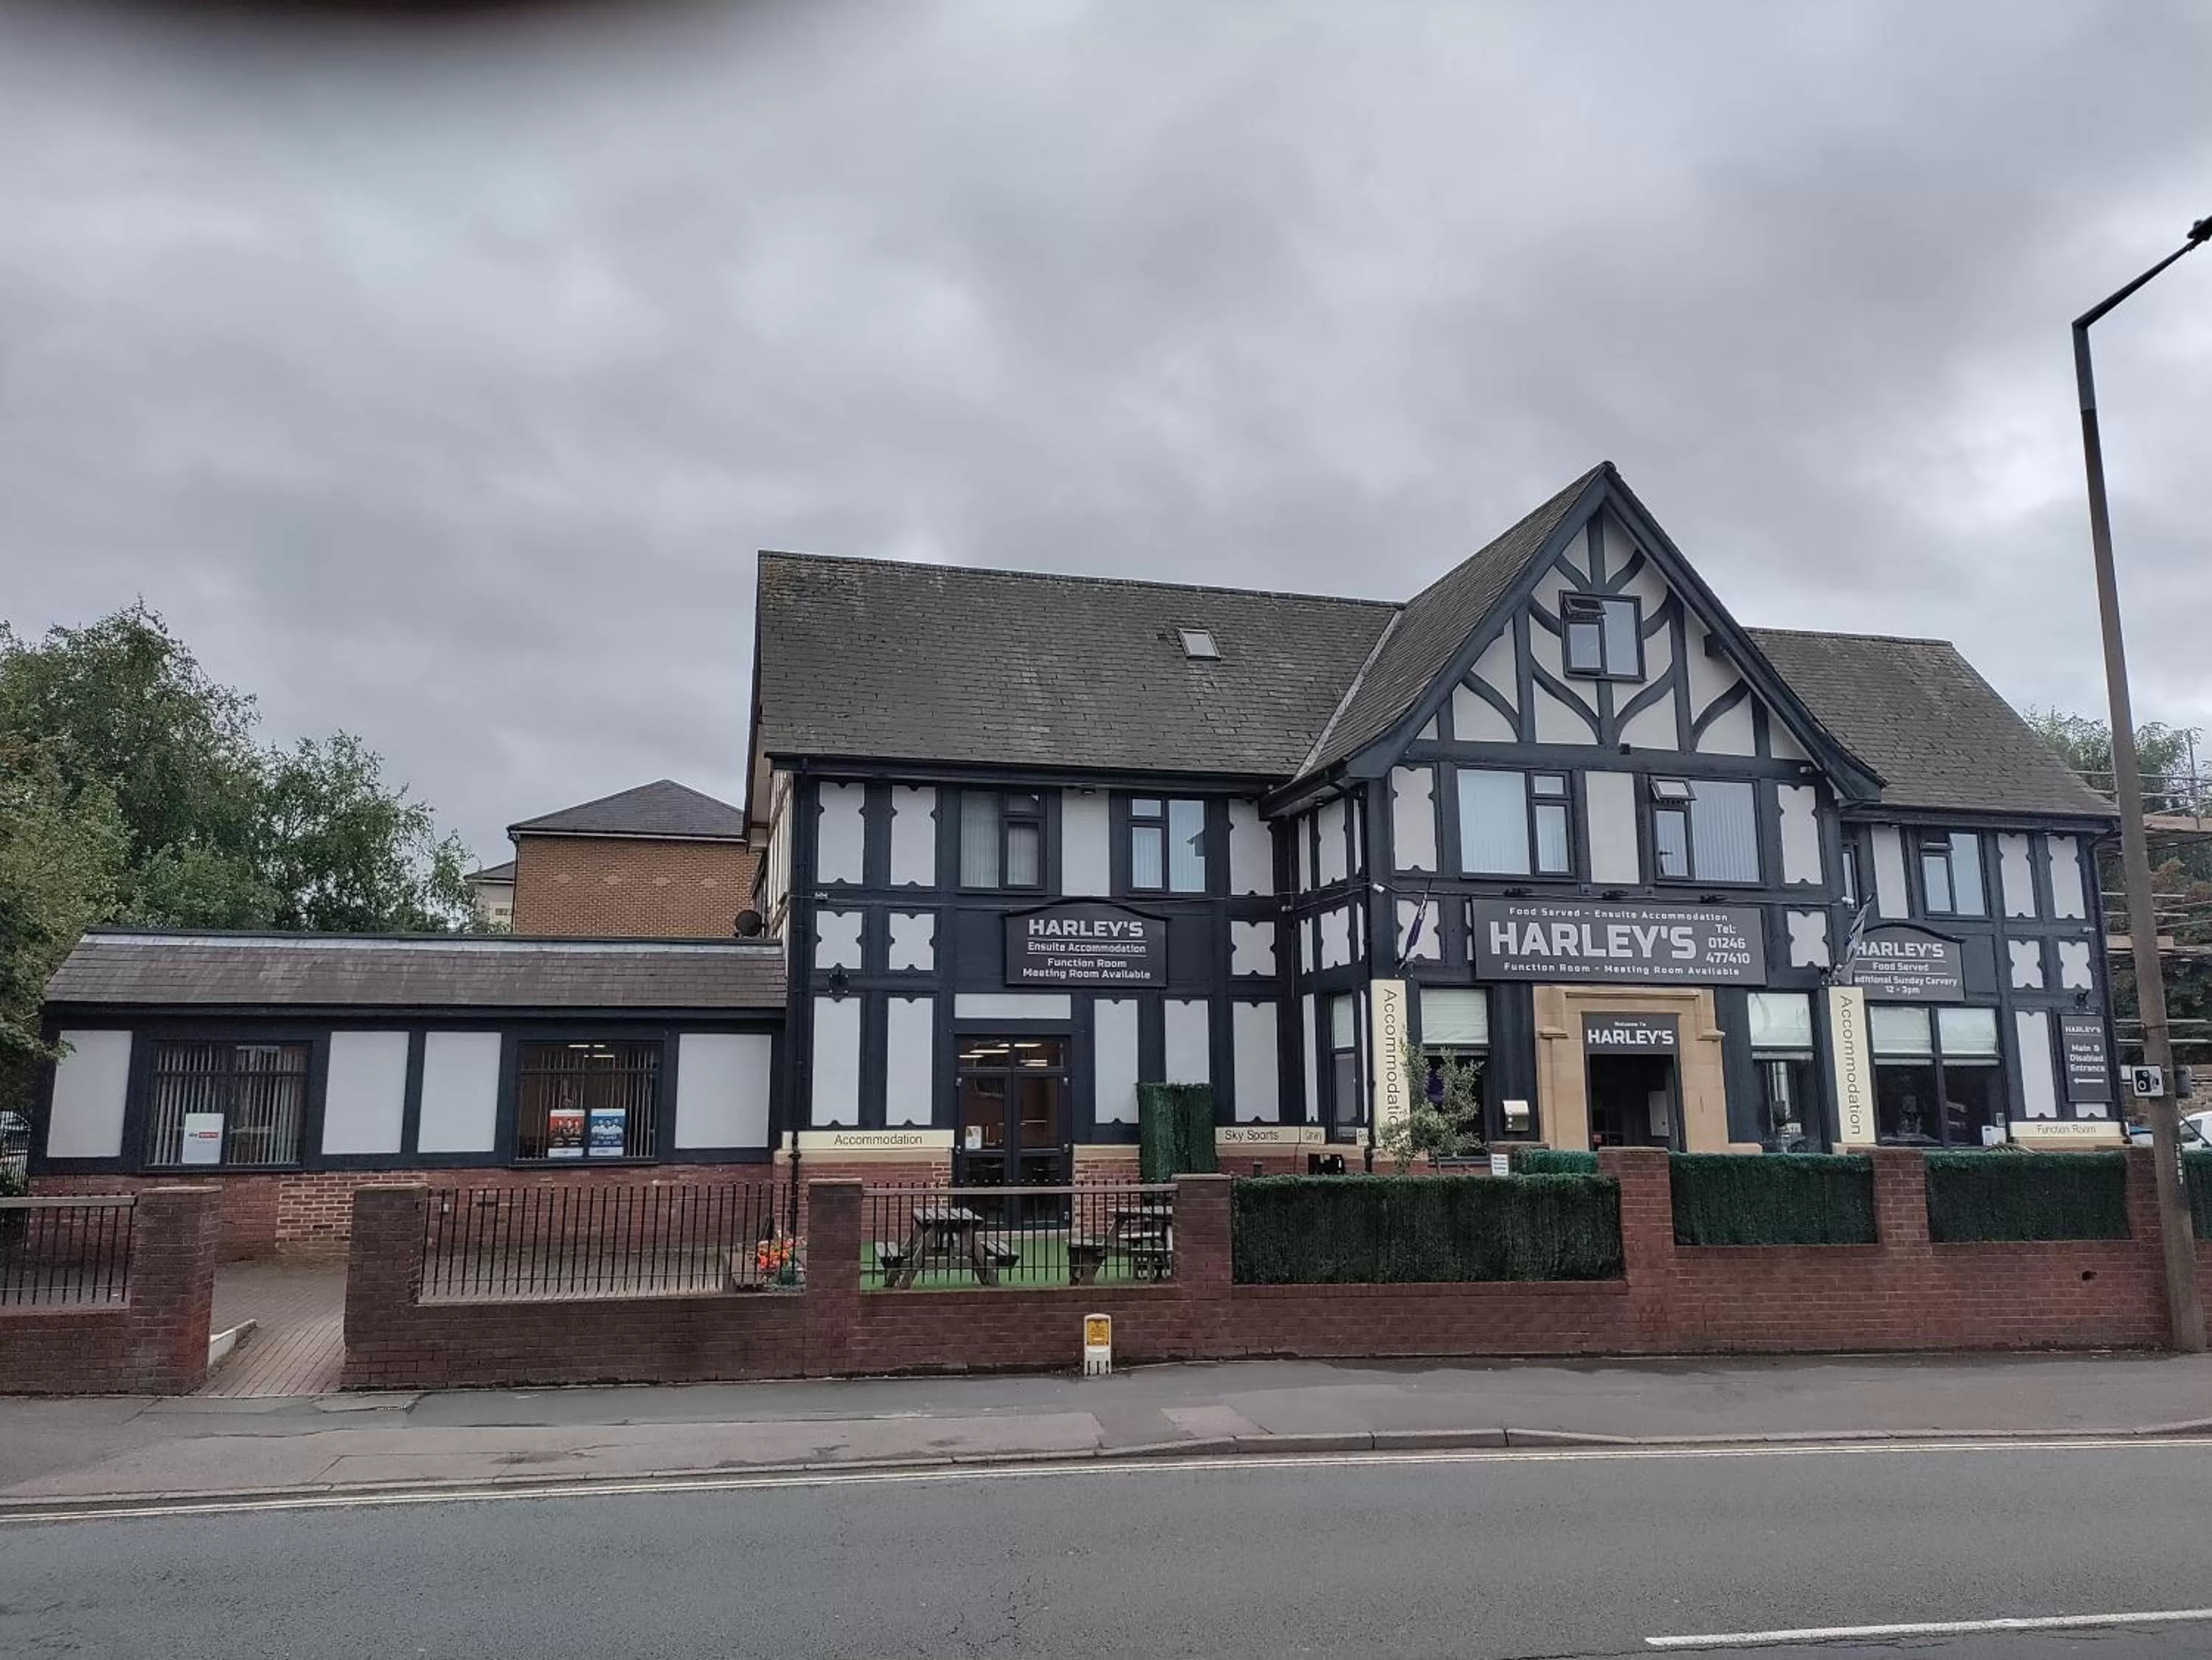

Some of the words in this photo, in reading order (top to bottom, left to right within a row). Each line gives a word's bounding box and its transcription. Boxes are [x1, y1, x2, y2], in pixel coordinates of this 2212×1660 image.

[1509, 907, 1537, 916] Food
[1541, 907, 1580, 917] Served
[1595, 909, 1637, 919] Ensuite
[1642, 911, 1728, 921] Accommodation
[1029, 919, 1144, 937] HARLEY'S
[1715, 924, 1736, 934] Tel:
[1489, 921, 1697, 959] HARLEY'S
[1708, 937, 1746, 949] 01246
[1028, 941, 1065, 952] Ensuite
[1069, 944, 1146, 953] Accommodation
[1857, 941, 1944, 958] HARLEY'S
[1048, 958, 1094, 968] Function
[1097, 959, 1127, 969] Room
[1705, 952, 1750, 963] 477410
[1503, 962, 1555, 971] Function
[1559, 963, 1590, 972] Room
[1604, 966, 1649, 974] Meeting
[1654, 966, 1683, 974] Room
[1688, 967, 1740, 976] Available
[1873, 962, 1896, 971] Food
[1897, 963, 1929, 972] Served
[1023, 968, 1066, 979] Meeting
[1070, 970, 1099, 978] Room
[1102, 970, 1151, 979] Available
[1854, 975, 1892, 984] aditional
[1893, 976, 1924, 986] Sunday
[1925, 977, 1958, 987] Carvery
[1885, 986, 1894, 994] 12
[1587, 1030, 1674, 1045] HARLEY'S
[2071, 1044, 2091, 1052] Main
[1383, 988, 1401, 1126] Accommodatio
[2070, 1054, 2104, 1062] Disabled
[1840, 994, 1861, 1135] Accommodation
[2070, 1064, 2106, 1073] Entrance
[2037, 1124, 2070, 1133] Function
[2073, 1124, 2096, 1133] Room
[834, 1134, 922, 1145] Accommodation
[1225, 1129, 1244, 1143] Sky
[1247, 1129, 1279, 1141] Sports
